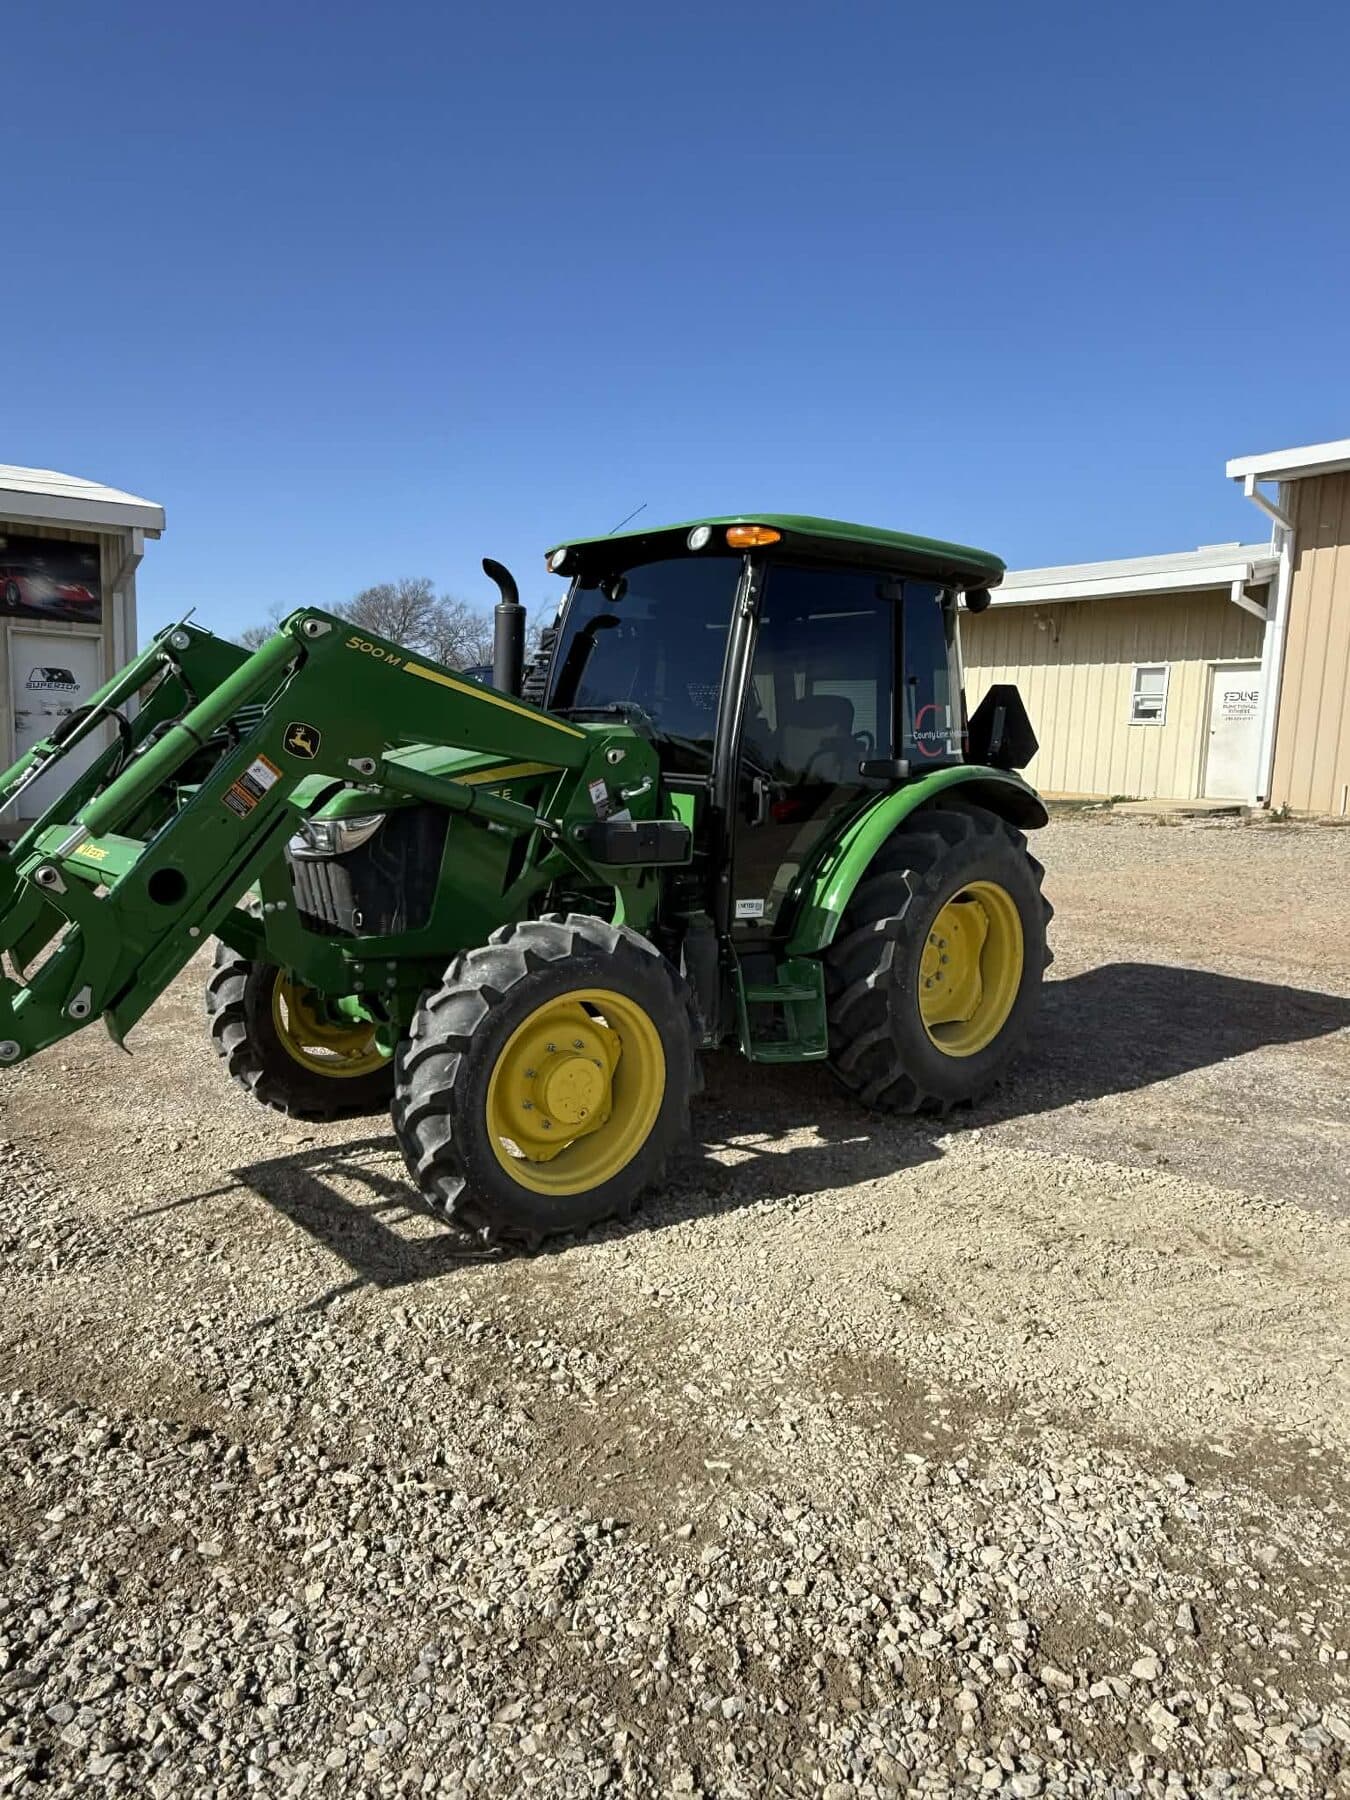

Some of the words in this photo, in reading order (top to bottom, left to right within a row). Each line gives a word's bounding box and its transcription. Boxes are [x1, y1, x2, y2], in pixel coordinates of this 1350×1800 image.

[25, 682, 80, 691] SUPERIOR
[1223, 691, 1259, 702] REDLINE
[913, 730, 936, 741] County
